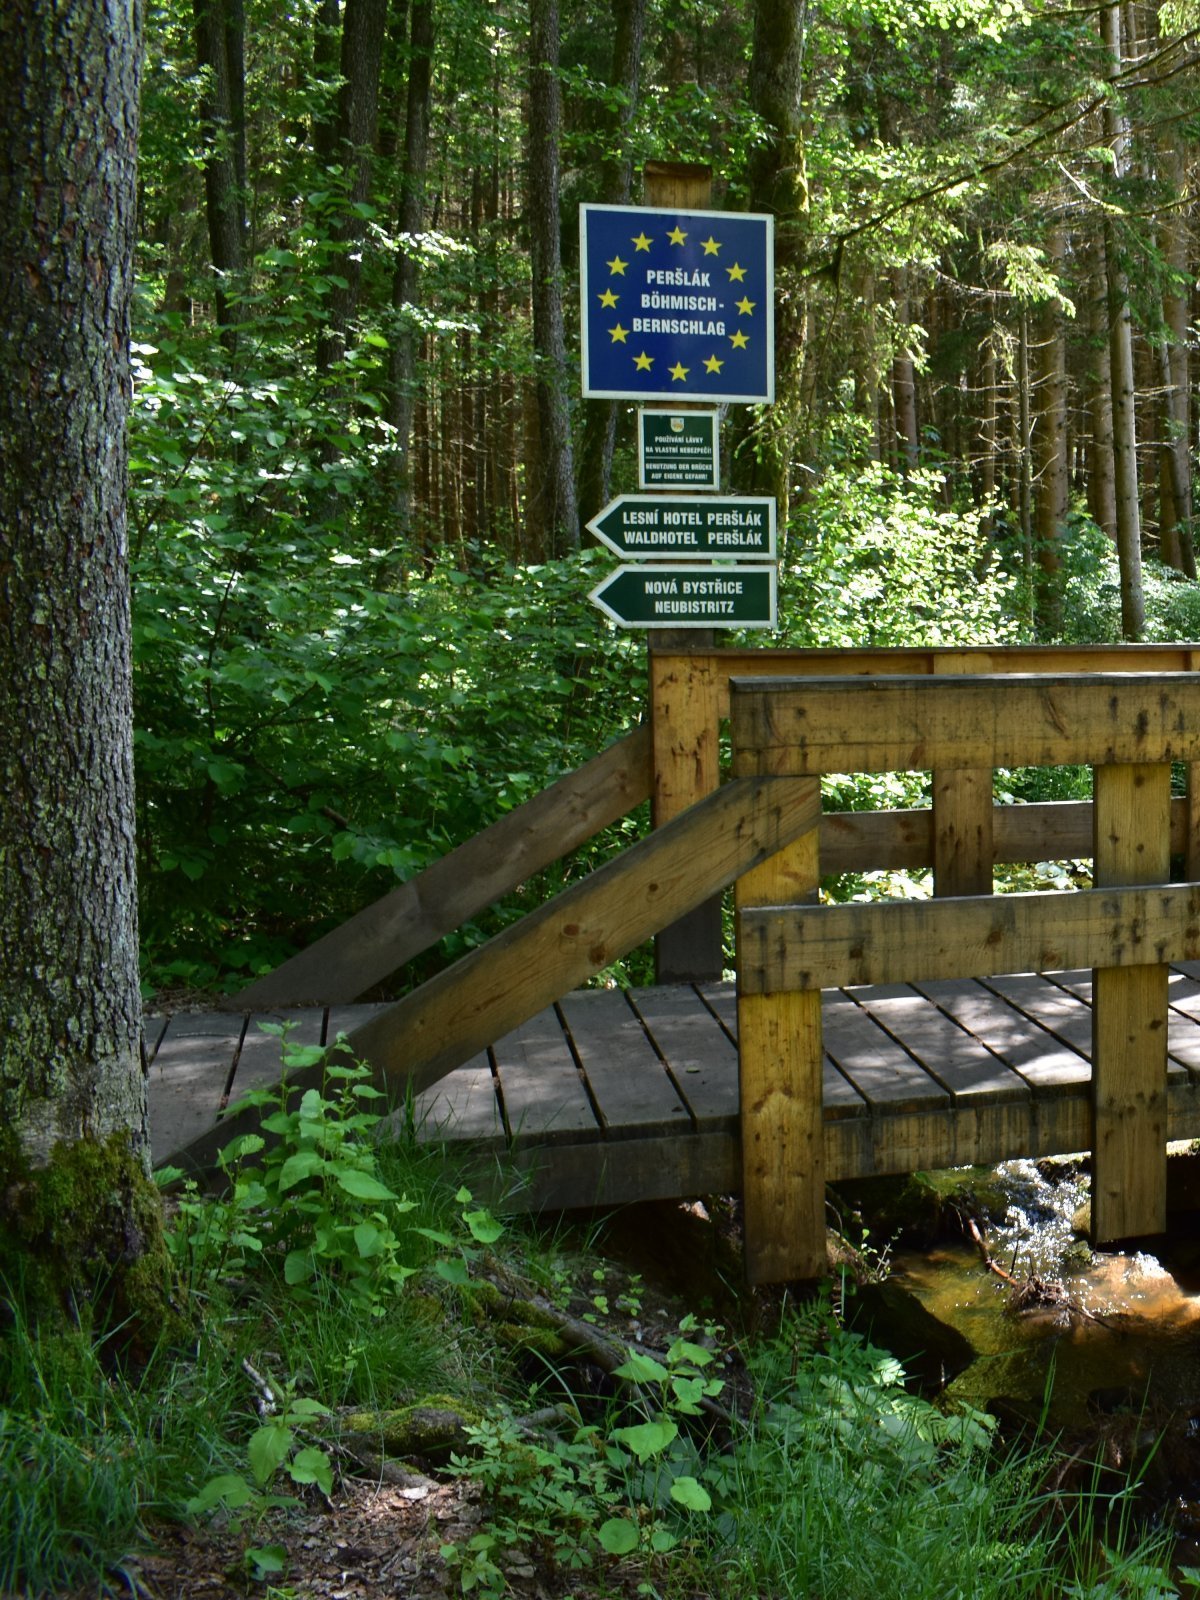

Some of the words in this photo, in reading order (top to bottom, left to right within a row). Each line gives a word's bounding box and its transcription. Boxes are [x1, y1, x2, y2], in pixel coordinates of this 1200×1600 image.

[646, 267, 711, 288] PERŠLÁK
[632, 317, 726, 337] BERNSCHLAG
[686, 435, 703, 444] LÁVKY
[655, 446, 678, 454] VLASTNÍ
[622, 508, 659, 525] LESNÍ
[663, 511, 703, 526] HOTEL
[707, 509, 762, 527] PERŠLÁK
[623, 530, 699, 545] WALDHOTEL
[707, 528, 762, 546] PERŠLÁK
[644, 577, 679, 594] NOVÁ
[682, 578, 743, 595] BYSTŘICE
[654, 599, 735, 614] NEUBISTRITZ
